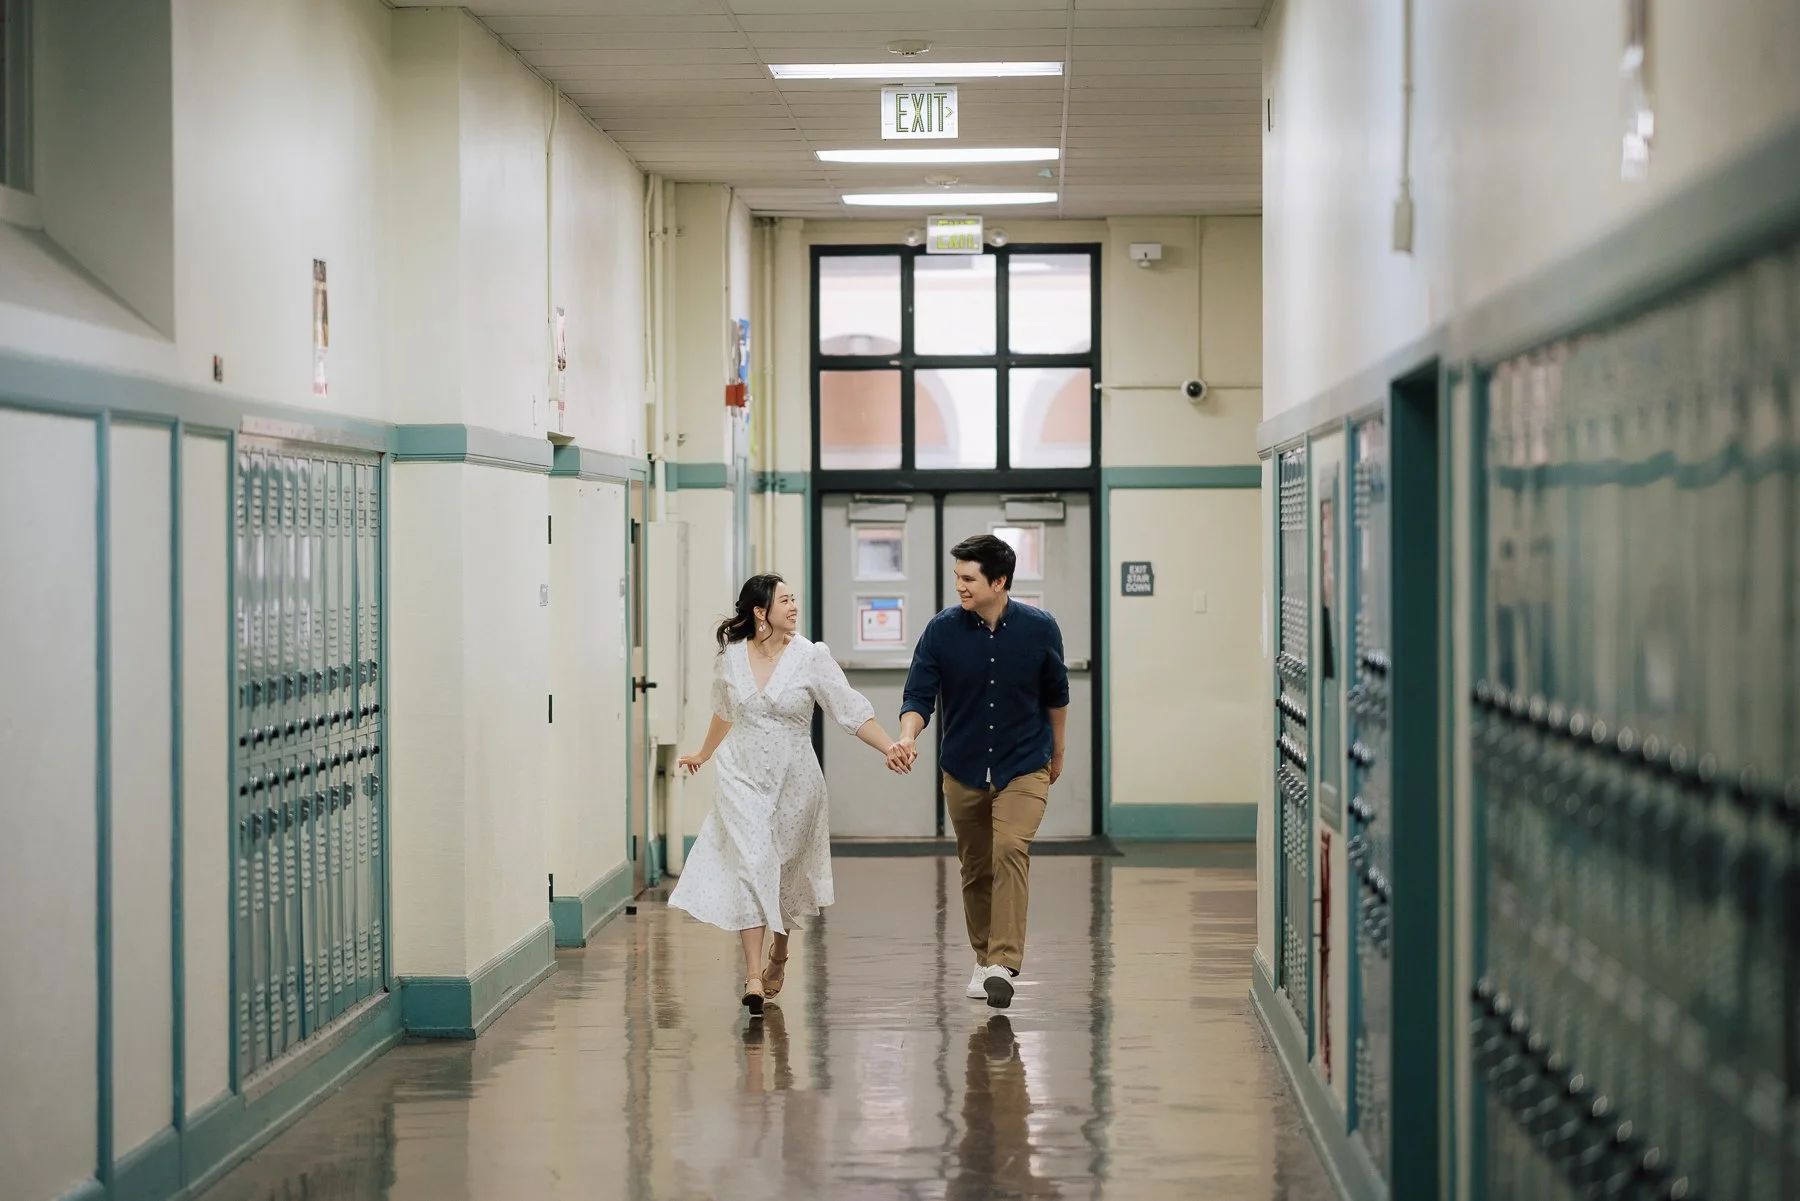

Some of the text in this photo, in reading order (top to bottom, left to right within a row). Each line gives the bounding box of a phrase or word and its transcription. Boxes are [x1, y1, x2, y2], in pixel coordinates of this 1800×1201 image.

[896, 93, 947, 132] EXIT
[1129, 565, 1147, 574] EXIT
[1127, 574, 1149, 583] STAIR
[1126, 583, 1151, 592] DOWN
